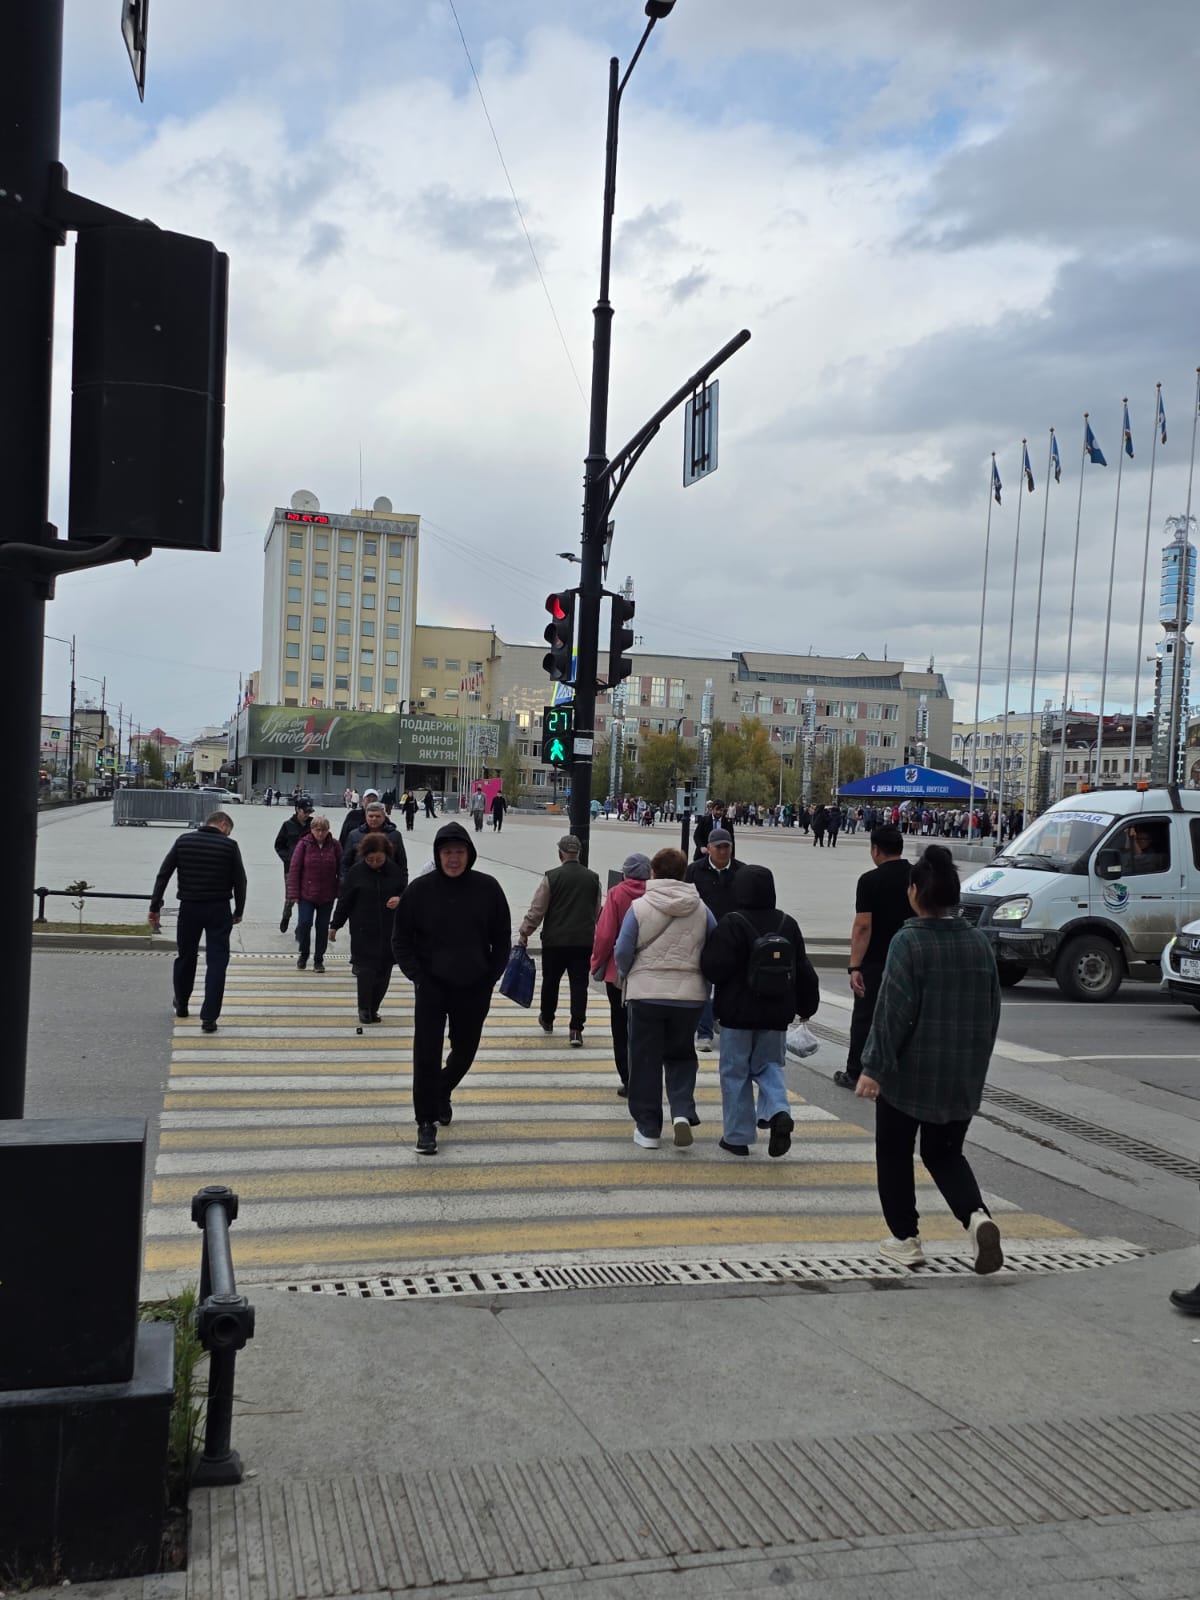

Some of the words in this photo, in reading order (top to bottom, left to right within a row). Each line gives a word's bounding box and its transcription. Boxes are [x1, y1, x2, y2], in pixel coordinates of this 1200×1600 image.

[400, 718, 460, 732] ПОДДЕРЖИ
[549, 711, 567, 732] 27
[411, 734, 459, 746] ВОИНОВ-
[418, 749, 458, 761] ЯКУТЯН
